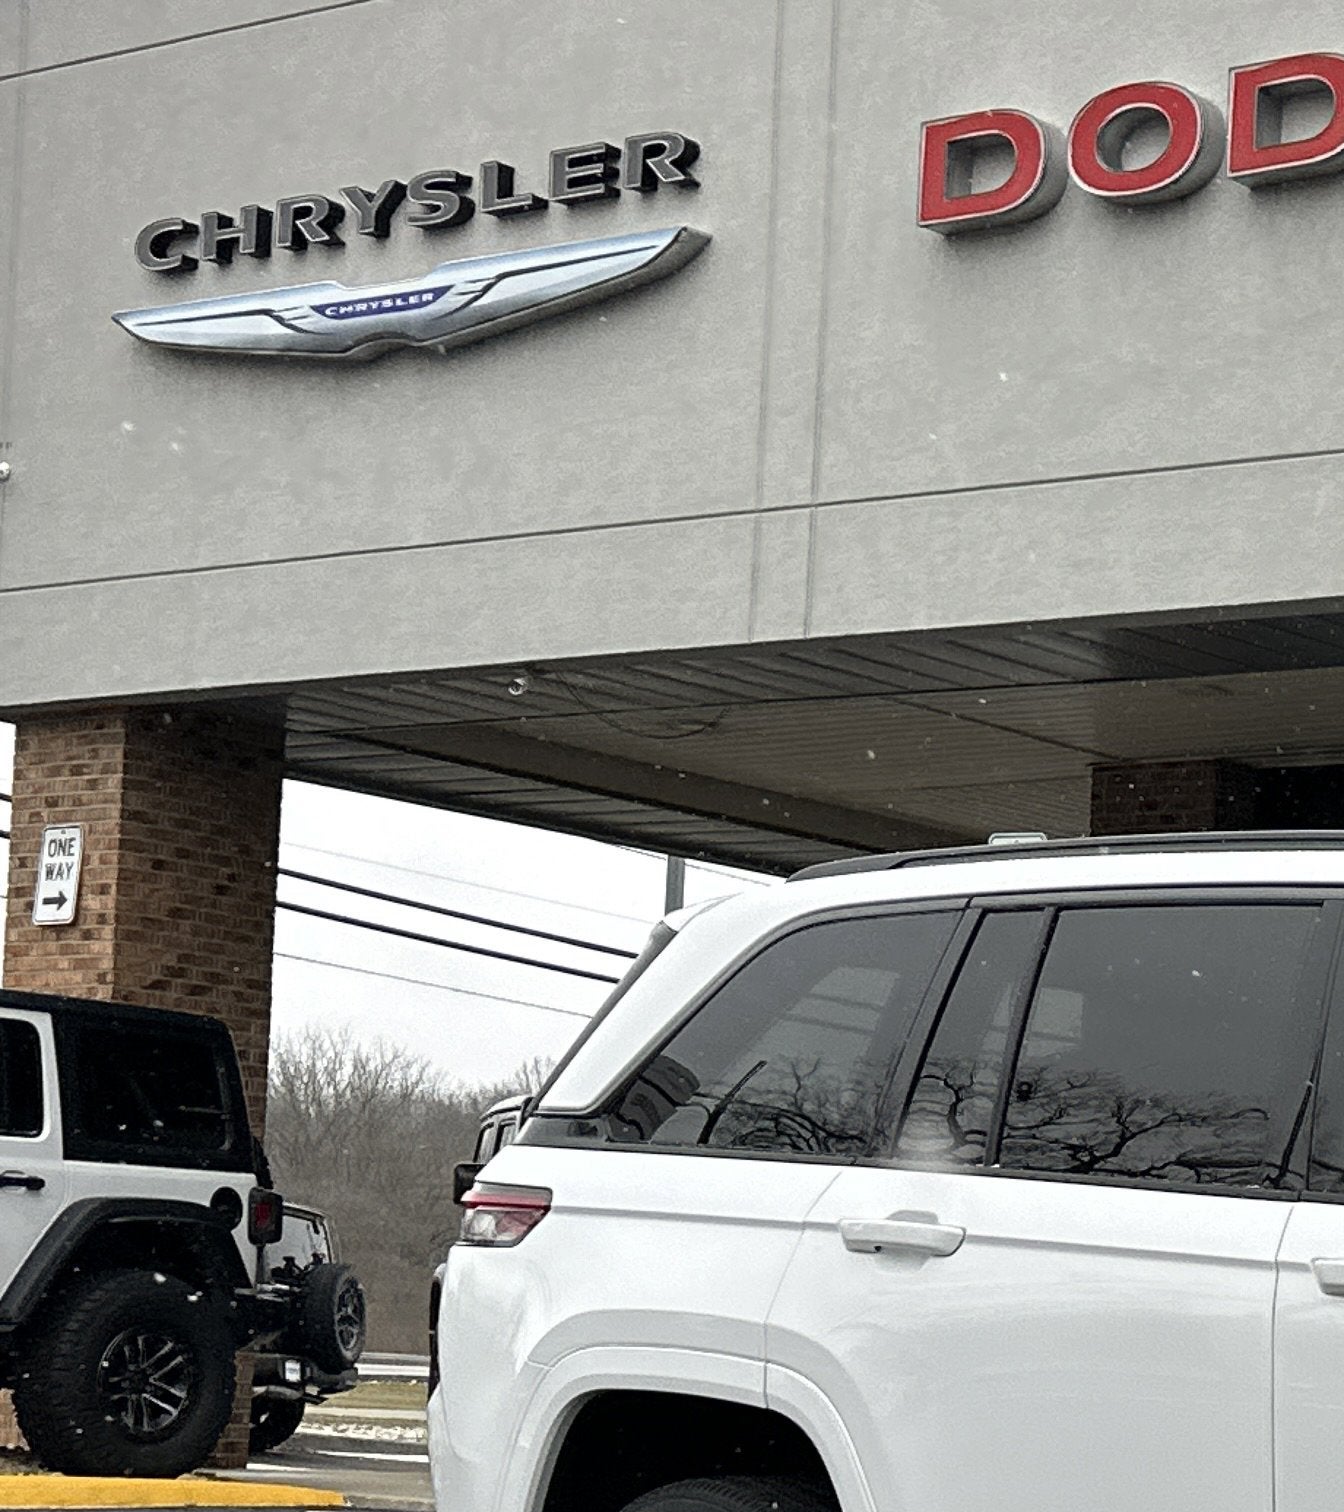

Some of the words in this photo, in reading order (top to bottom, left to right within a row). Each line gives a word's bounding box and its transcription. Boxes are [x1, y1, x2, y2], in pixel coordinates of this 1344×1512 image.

[135, 131, 698, 274] CHRYSLER
[324, 292, 435, 316] CHRYSLER
[47, 836, 77, 858] ONE
[45, 861, 75, 882] WAY
